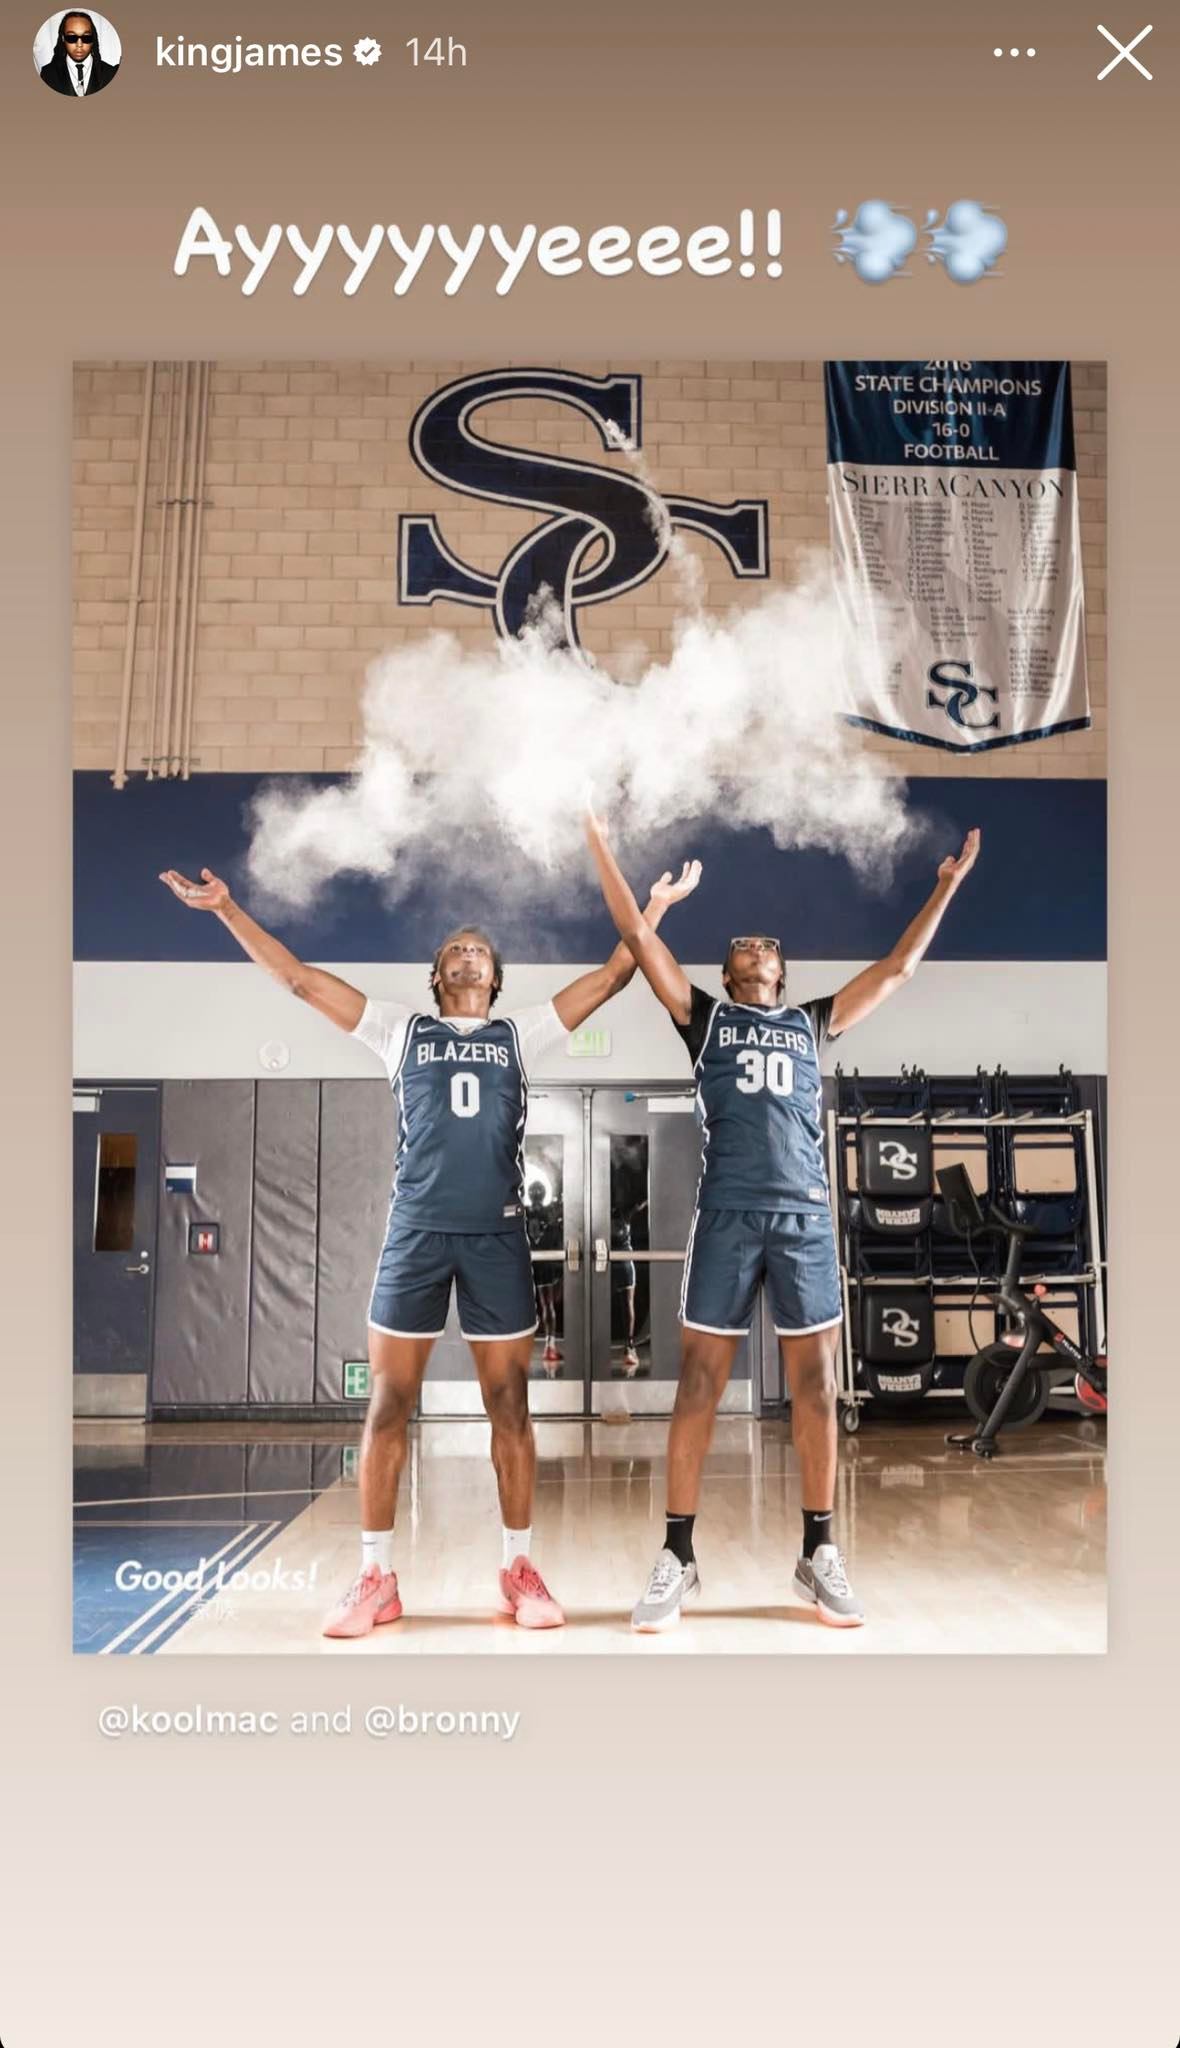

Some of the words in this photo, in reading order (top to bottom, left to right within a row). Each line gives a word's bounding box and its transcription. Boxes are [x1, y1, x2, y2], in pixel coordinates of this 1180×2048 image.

[855, 375, 914, 392] STATE
[919, 377, 1042, 396] CHAMPIONS
[893, 401, 972, 417] DIVISION
[977, 403, 1007, 417] II-A
[932, 423, 970, 437] 16-0
[904, 444, 1000, 461] FOOTBALL
[718, 1026, 808, 1055] BLAZERS
[417, 1042, 509, 1068] BLAZERS
[735, 1049, 795, 1098] 30
[450, 1072, 480, 1118] 0
